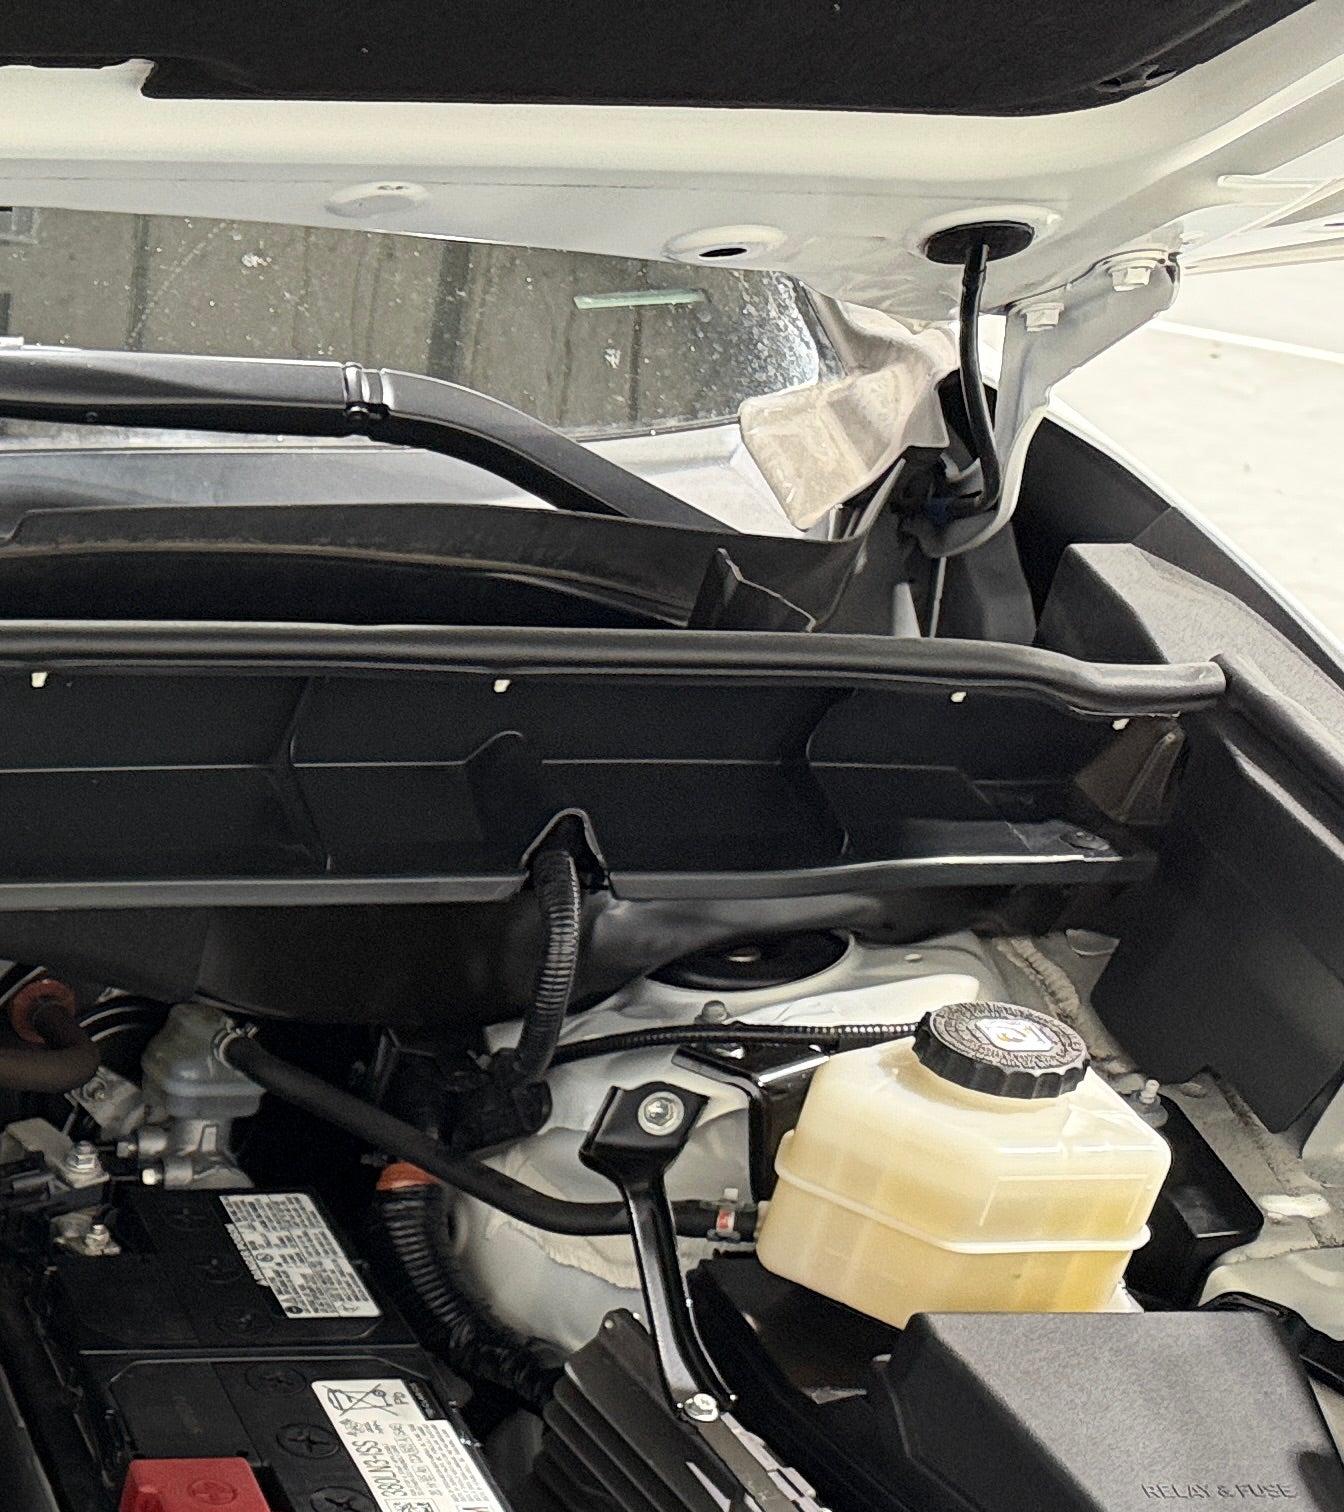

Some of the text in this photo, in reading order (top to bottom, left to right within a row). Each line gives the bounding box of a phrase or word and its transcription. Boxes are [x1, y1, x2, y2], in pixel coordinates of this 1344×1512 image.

[1140, 1483, 1298, 1500] RELAY & FUSE
